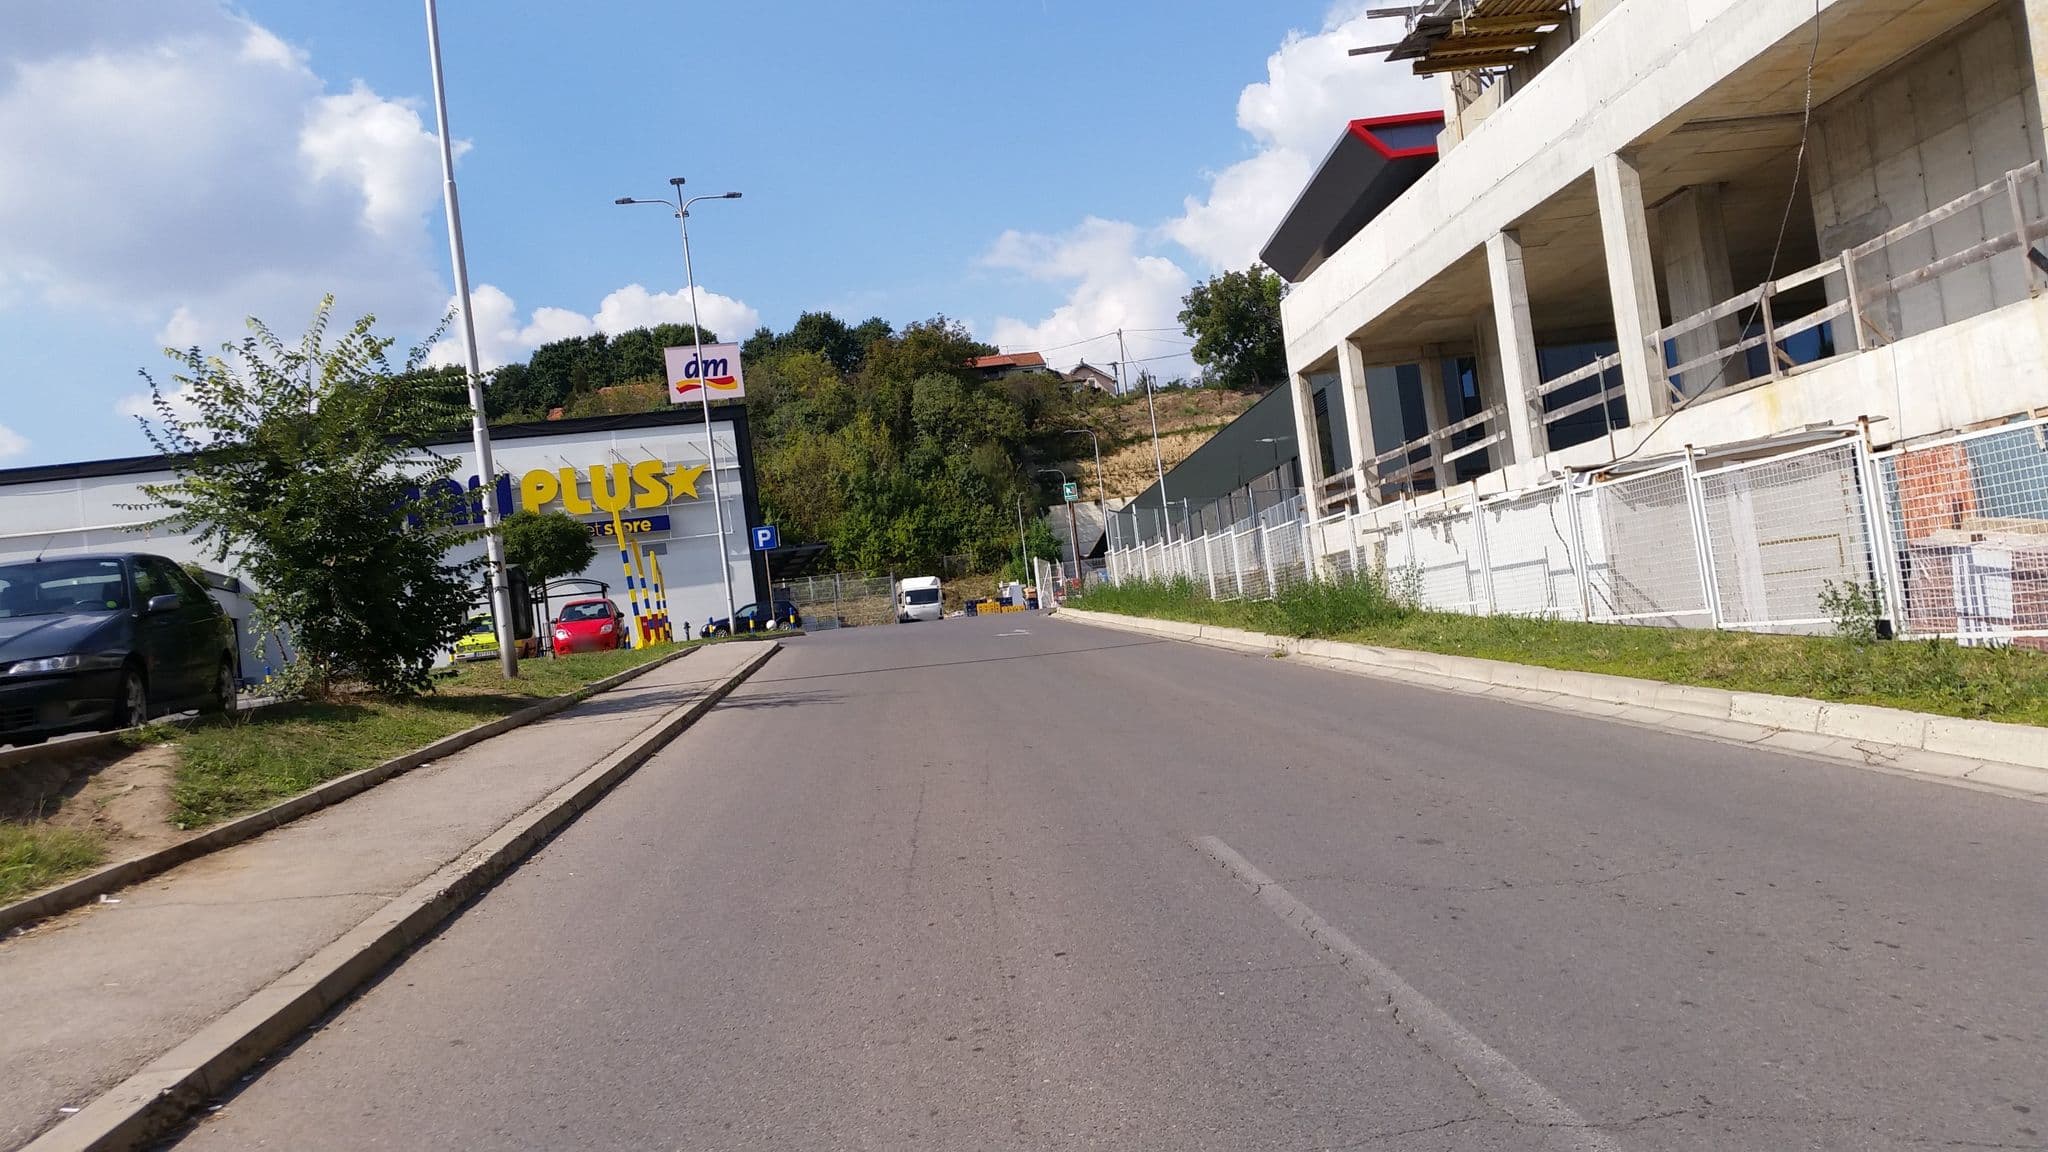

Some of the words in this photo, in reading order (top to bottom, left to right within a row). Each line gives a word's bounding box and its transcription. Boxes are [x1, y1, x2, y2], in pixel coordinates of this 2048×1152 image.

[684, 352, 728, 378] dm
[520, 459, 669, 515] PLUS
[758, 530, 771, 547] P
